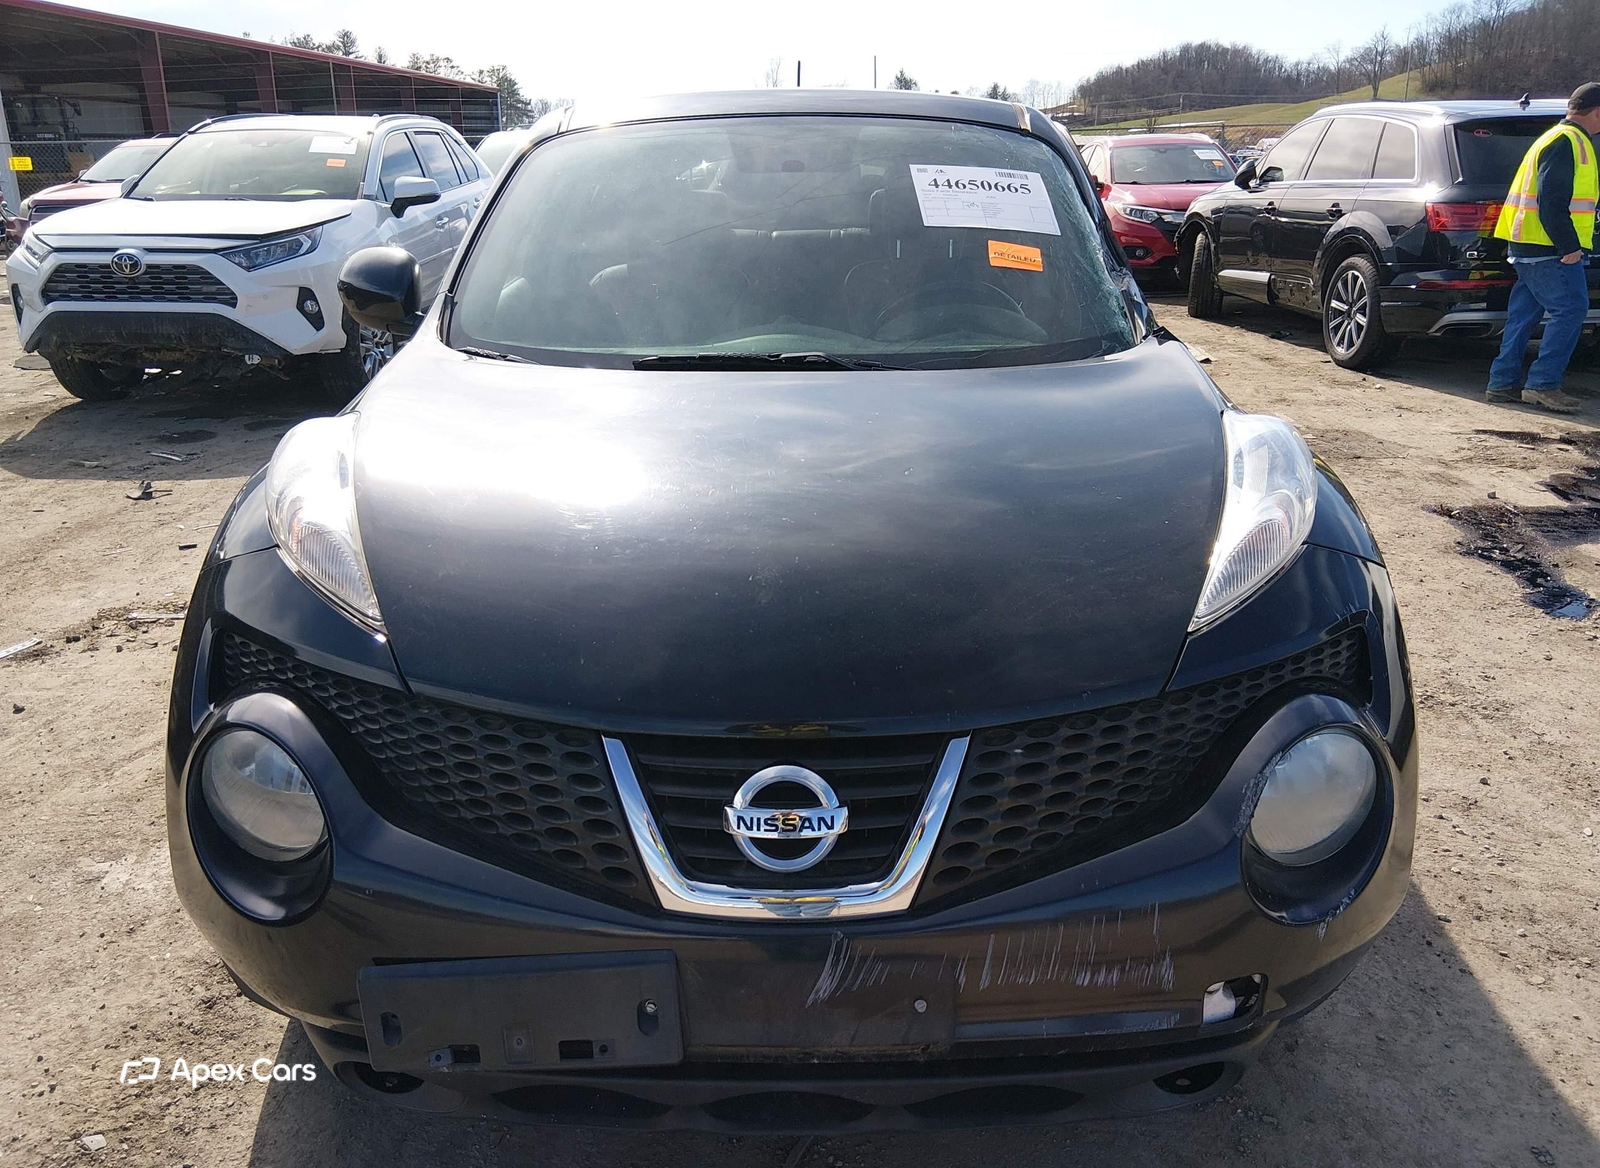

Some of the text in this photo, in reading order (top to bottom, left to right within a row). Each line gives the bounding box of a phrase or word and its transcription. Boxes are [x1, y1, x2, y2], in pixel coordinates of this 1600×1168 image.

[928, 177, 1032, 195] 44650665
[994, 251, 1037, 263] DETAILED
[1466, 251, 1487, 259] Q7
[736, 815, 835, 833] NISSAN
